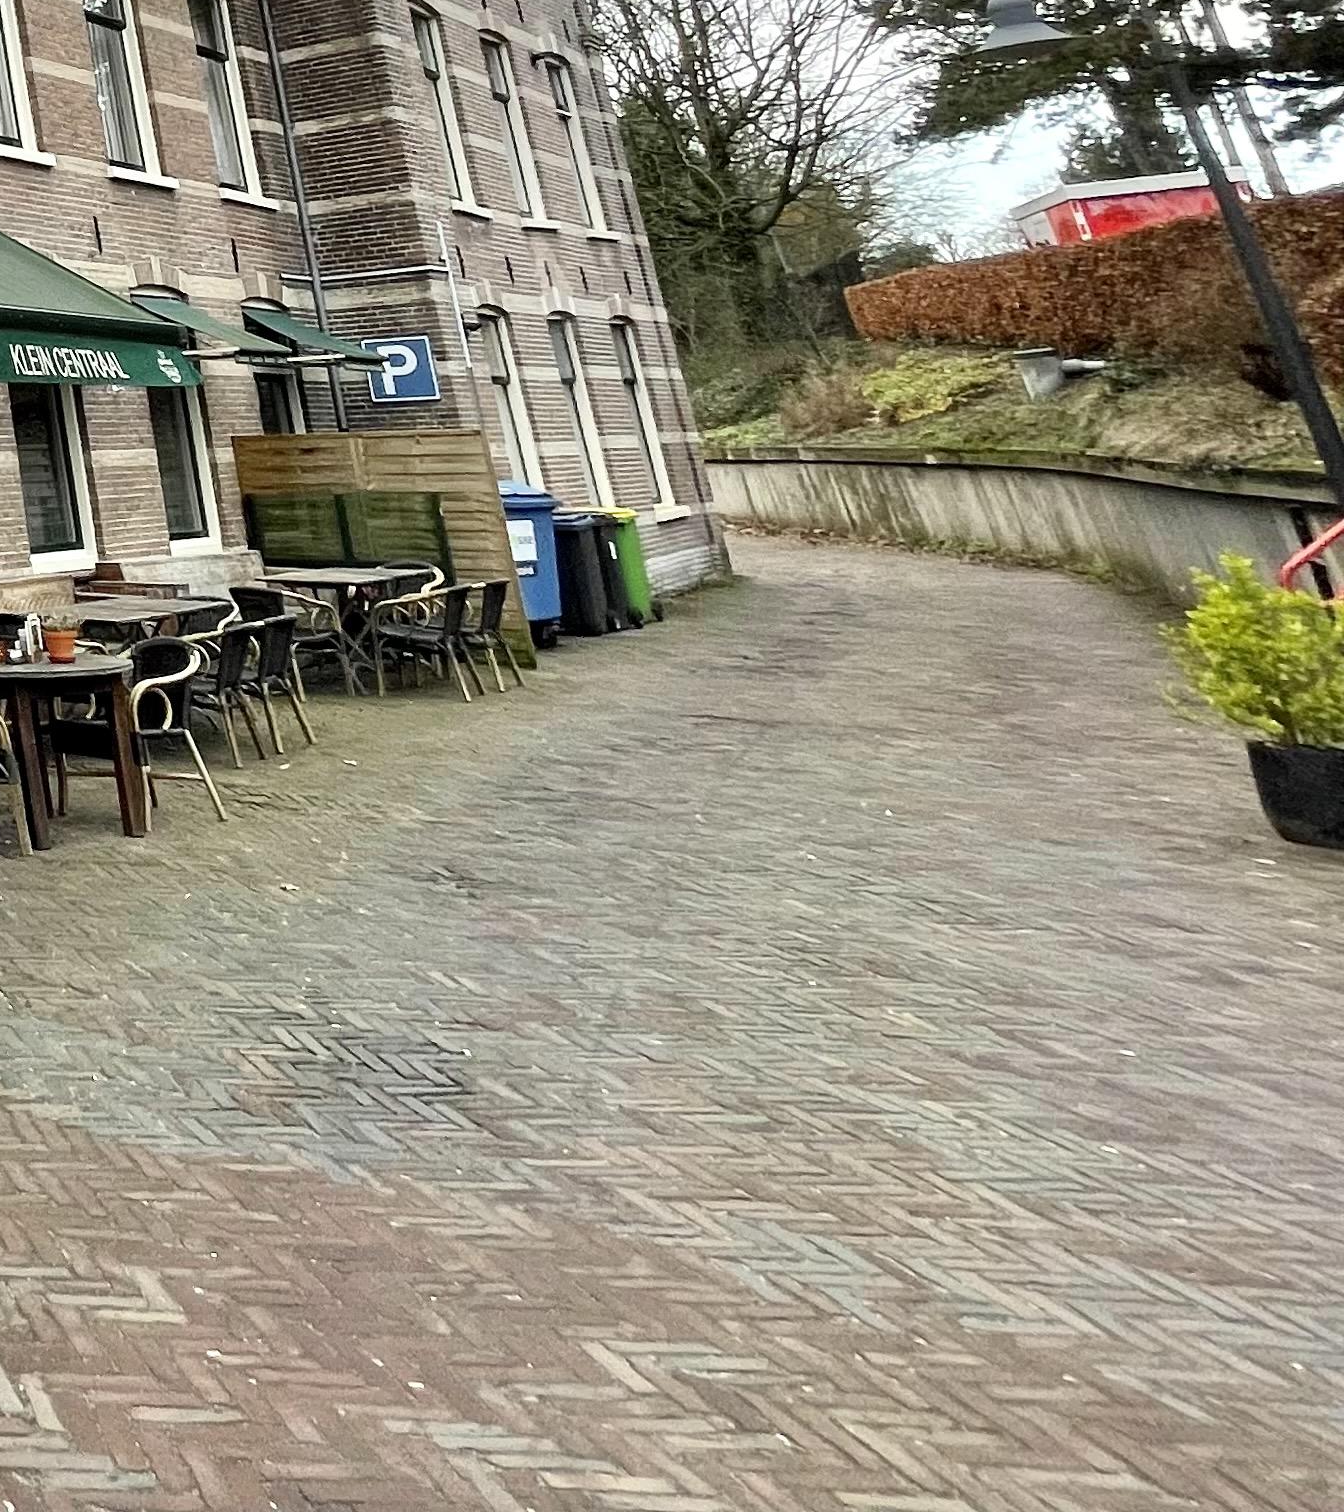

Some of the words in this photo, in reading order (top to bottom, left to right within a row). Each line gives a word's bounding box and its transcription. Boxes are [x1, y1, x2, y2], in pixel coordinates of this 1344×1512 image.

[9, 343, 56, 377] KLEIN
[54, 346, 131, 380] CENTRAAL
[376, 344, 418, 395] P
